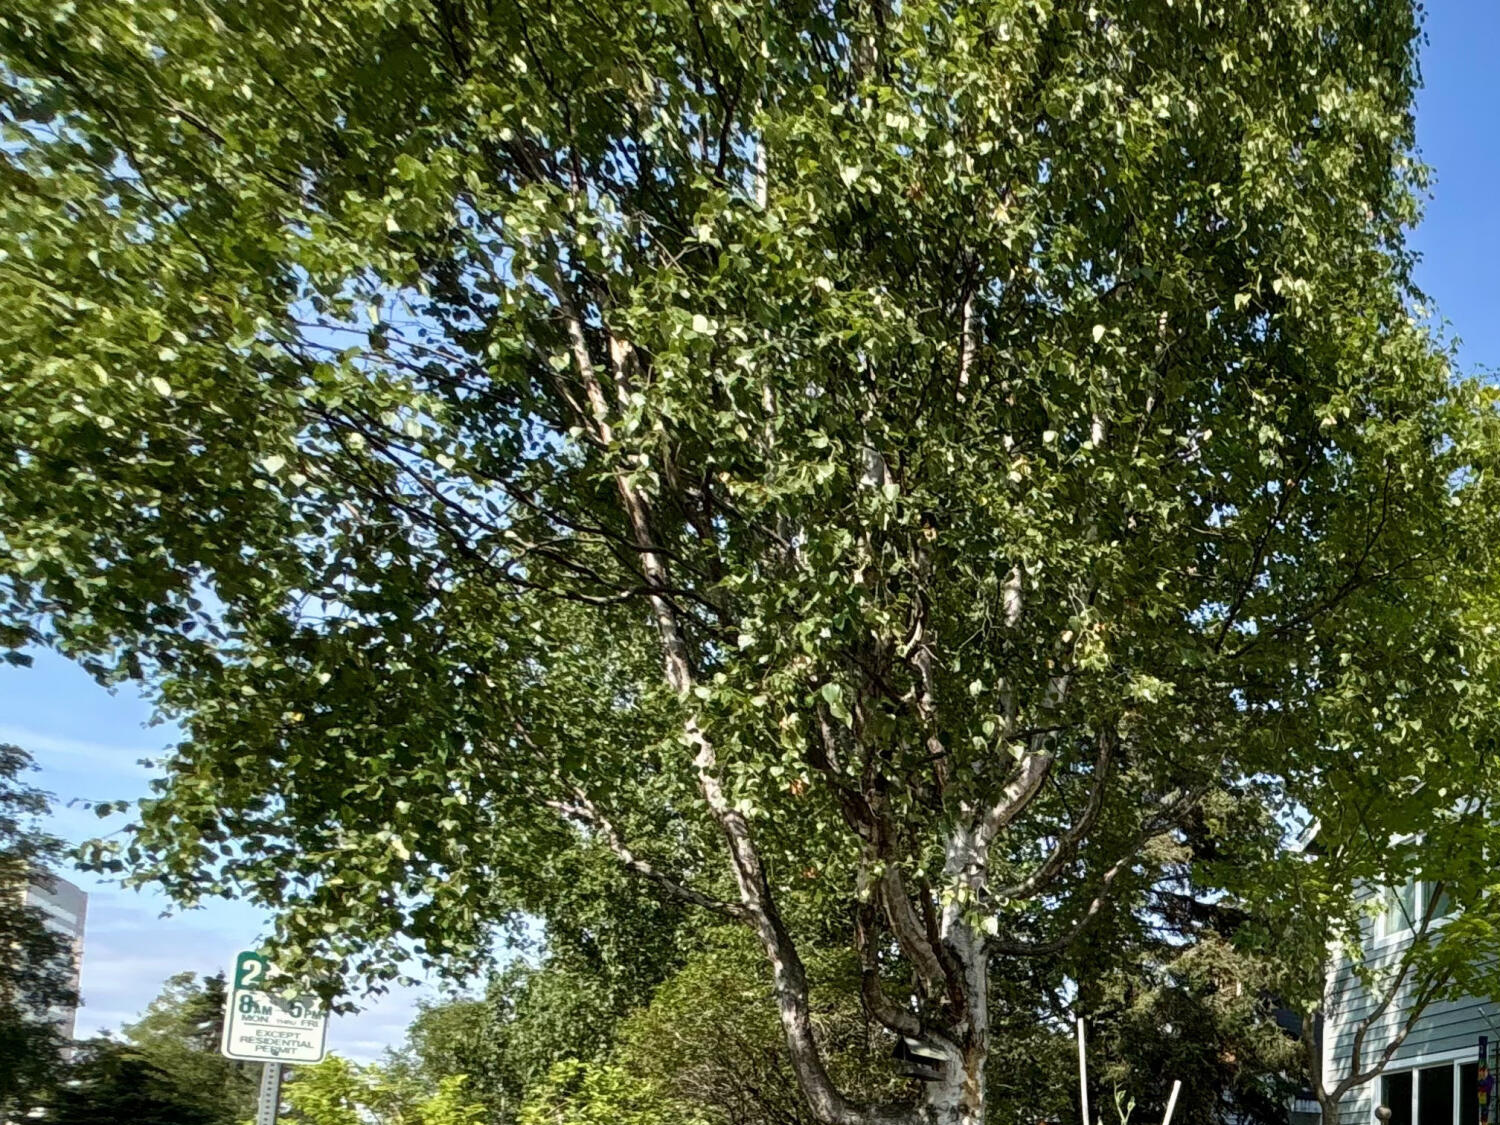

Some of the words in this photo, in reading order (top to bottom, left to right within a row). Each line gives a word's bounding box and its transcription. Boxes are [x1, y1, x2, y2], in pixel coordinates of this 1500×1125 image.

[241, 959, 262, 986] 2
[241, 1014, 269, 1022] MON
[255, 1029, 301, 1039] EXCEPT
[240, 1036, 315, 1049] RESIDENTIAL
